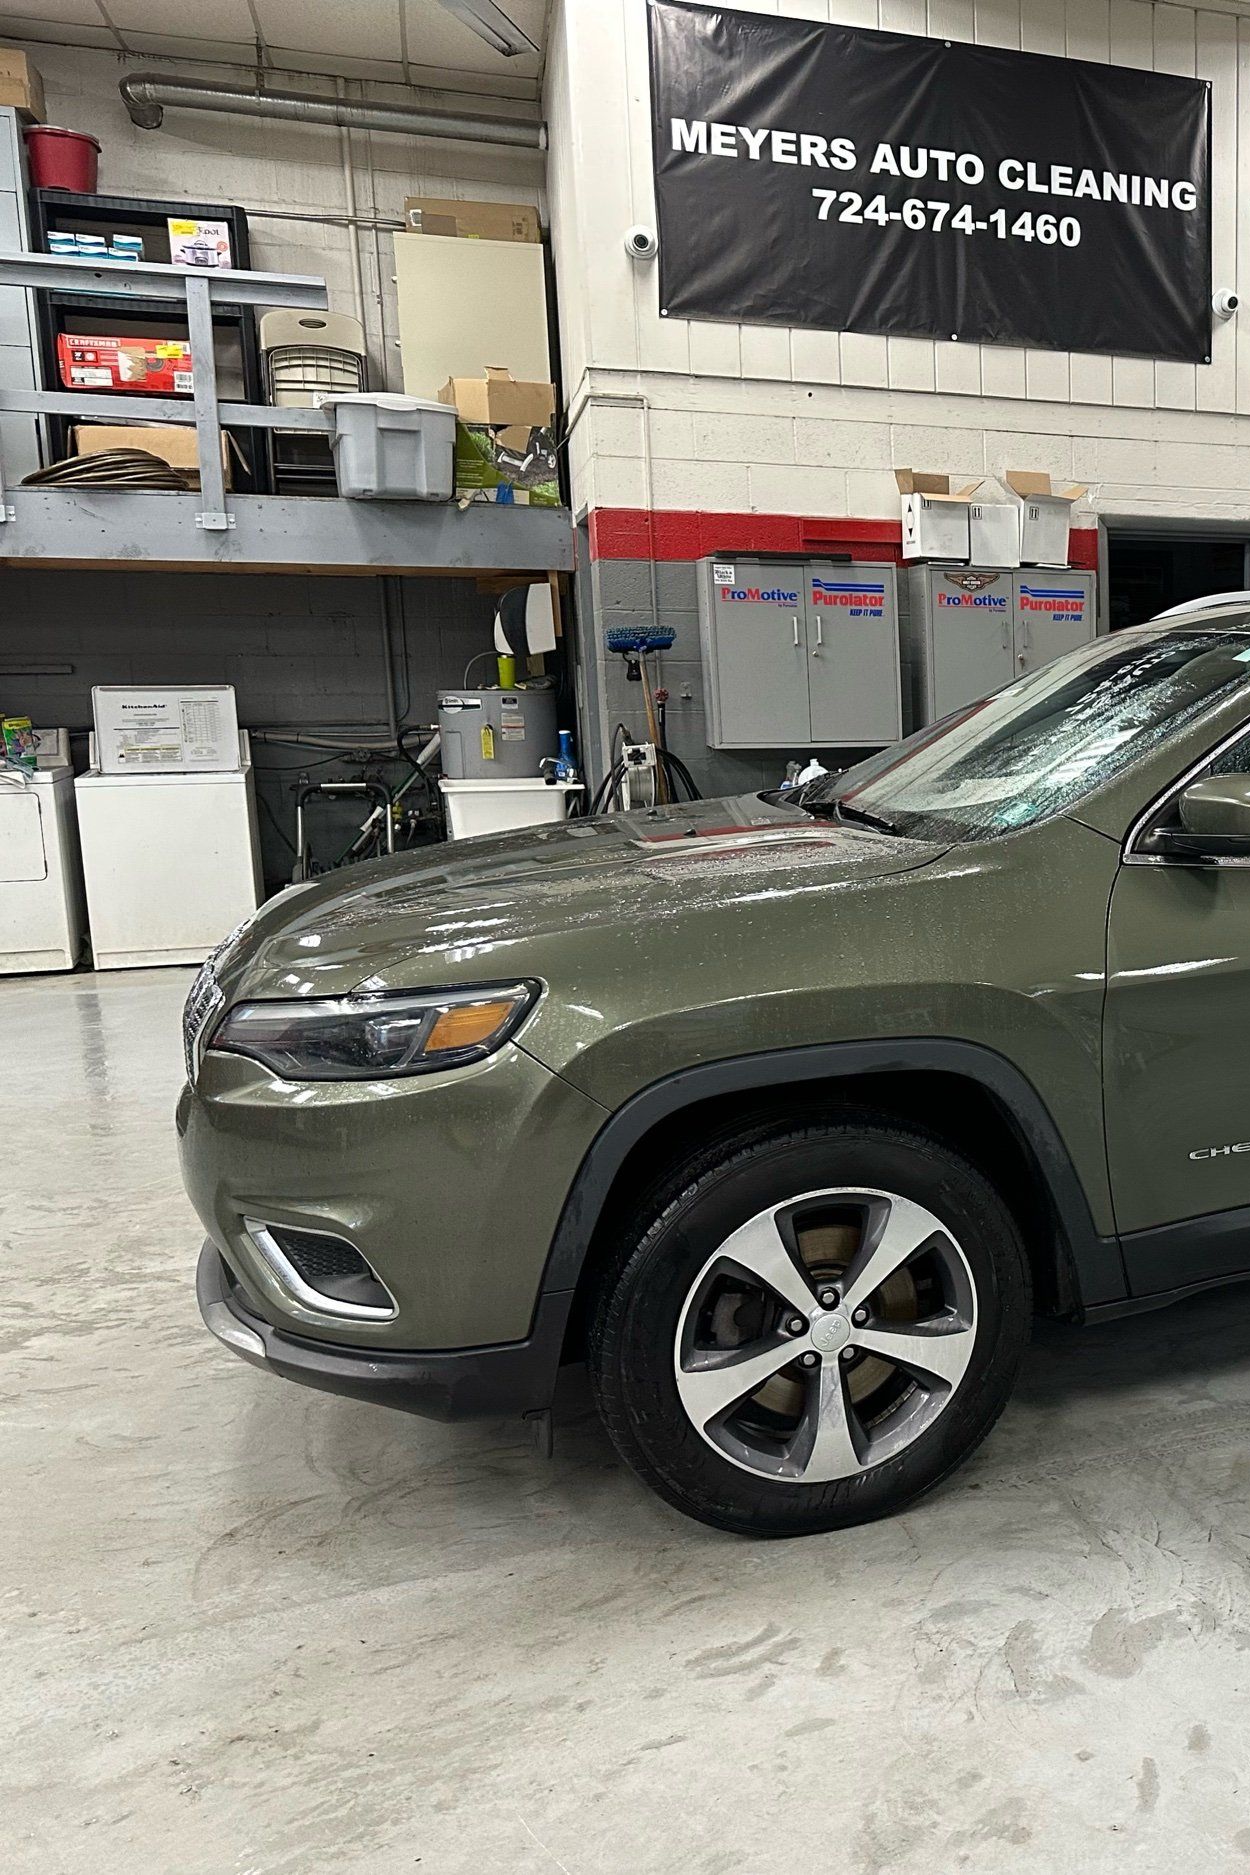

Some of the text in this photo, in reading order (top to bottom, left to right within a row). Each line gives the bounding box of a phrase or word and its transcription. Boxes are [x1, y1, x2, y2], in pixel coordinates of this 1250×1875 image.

[671, 117, 1198, 212] MEYERS AUTO CLEANING
[811, 187, 1081, 248] 724-674-1460
[721, 587, 798, 601] ProMotive
[812, 590, 885, 607] Purolator
[938, 592, 1007, 607] ProMotive
[1020, 595, 1085, 612] Purolator
[849, 608, 861, 617] KEEP
